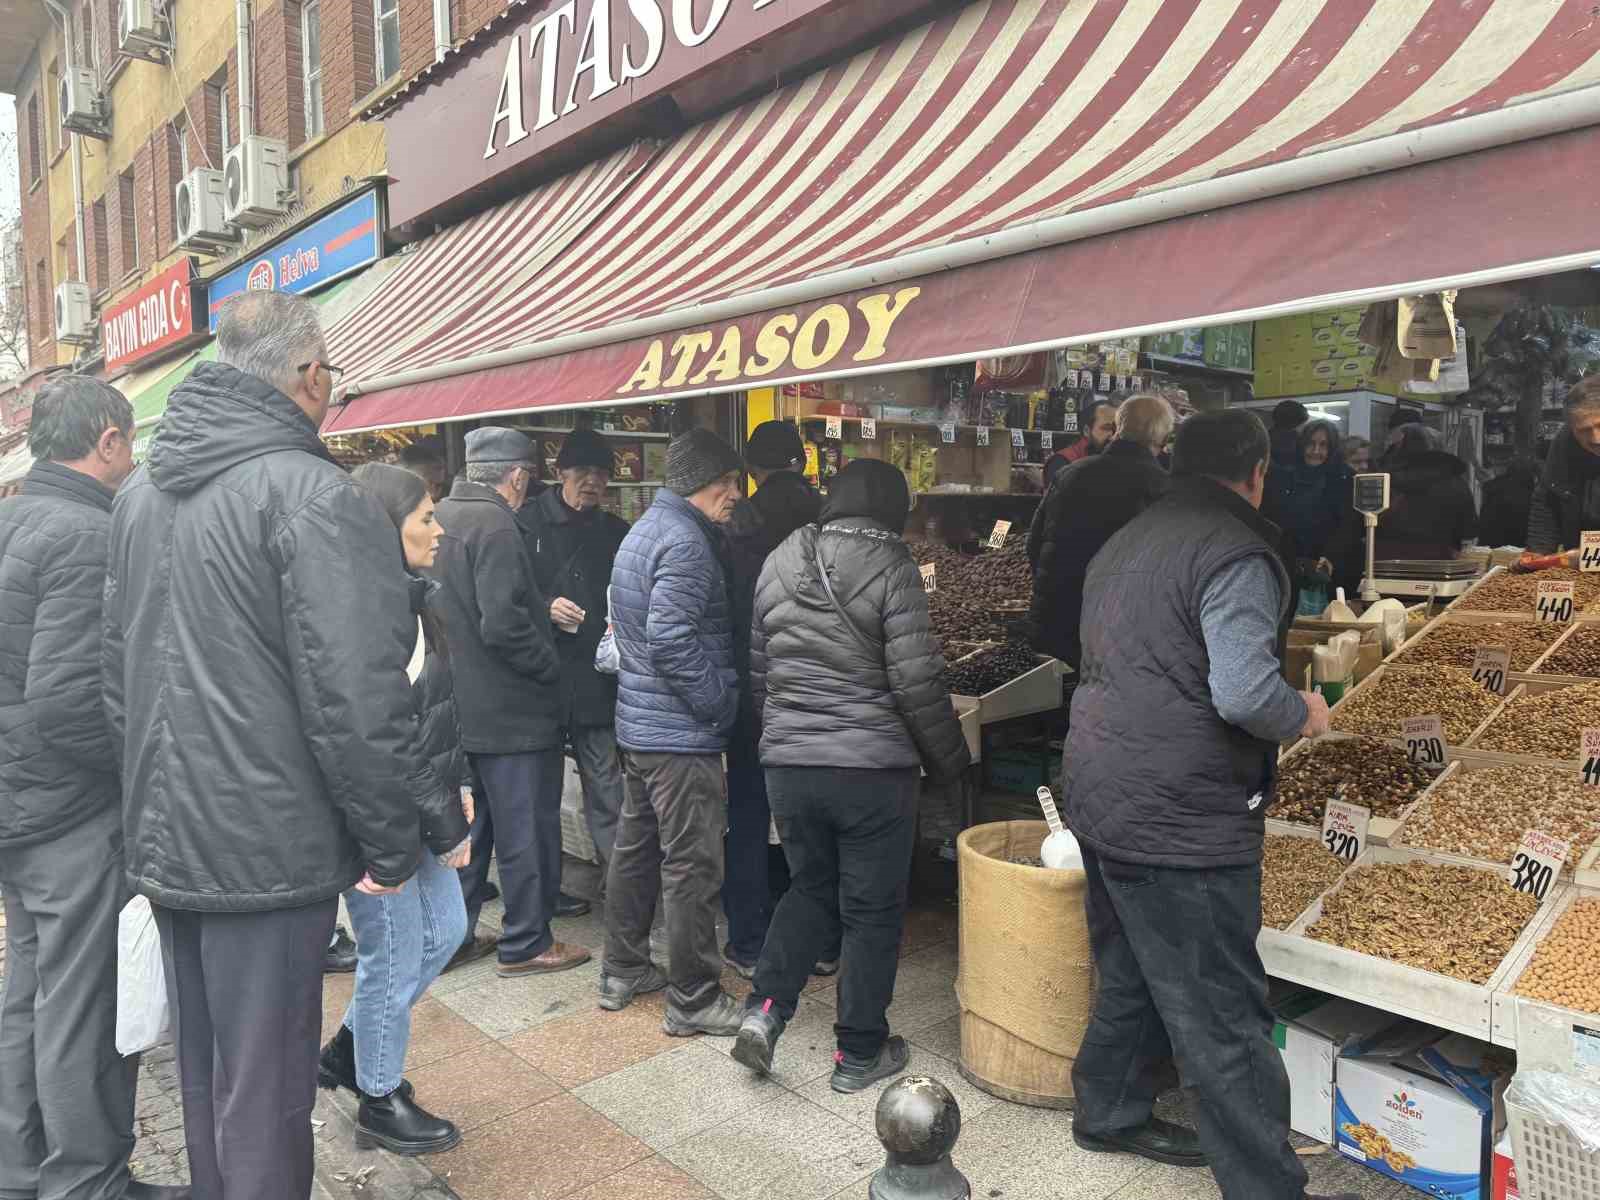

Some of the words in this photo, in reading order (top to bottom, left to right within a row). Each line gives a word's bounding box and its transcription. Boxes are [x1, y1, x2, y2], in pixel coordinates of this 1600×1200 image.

[279, 246, 320, 288] Helva
[105, 307, 138, 362] BAYIN
[139, 289, 169, 346] GIDA
[616, 287, 921, 394] ATASOY
[1537, 597, 1573, 622] 440
[1471, 668, 1504, 692] 450
[1407, 738, 1444, 763] 230
[1324, 829, 1359, 862] 320
[1511, 853, 1553, 901] 380
